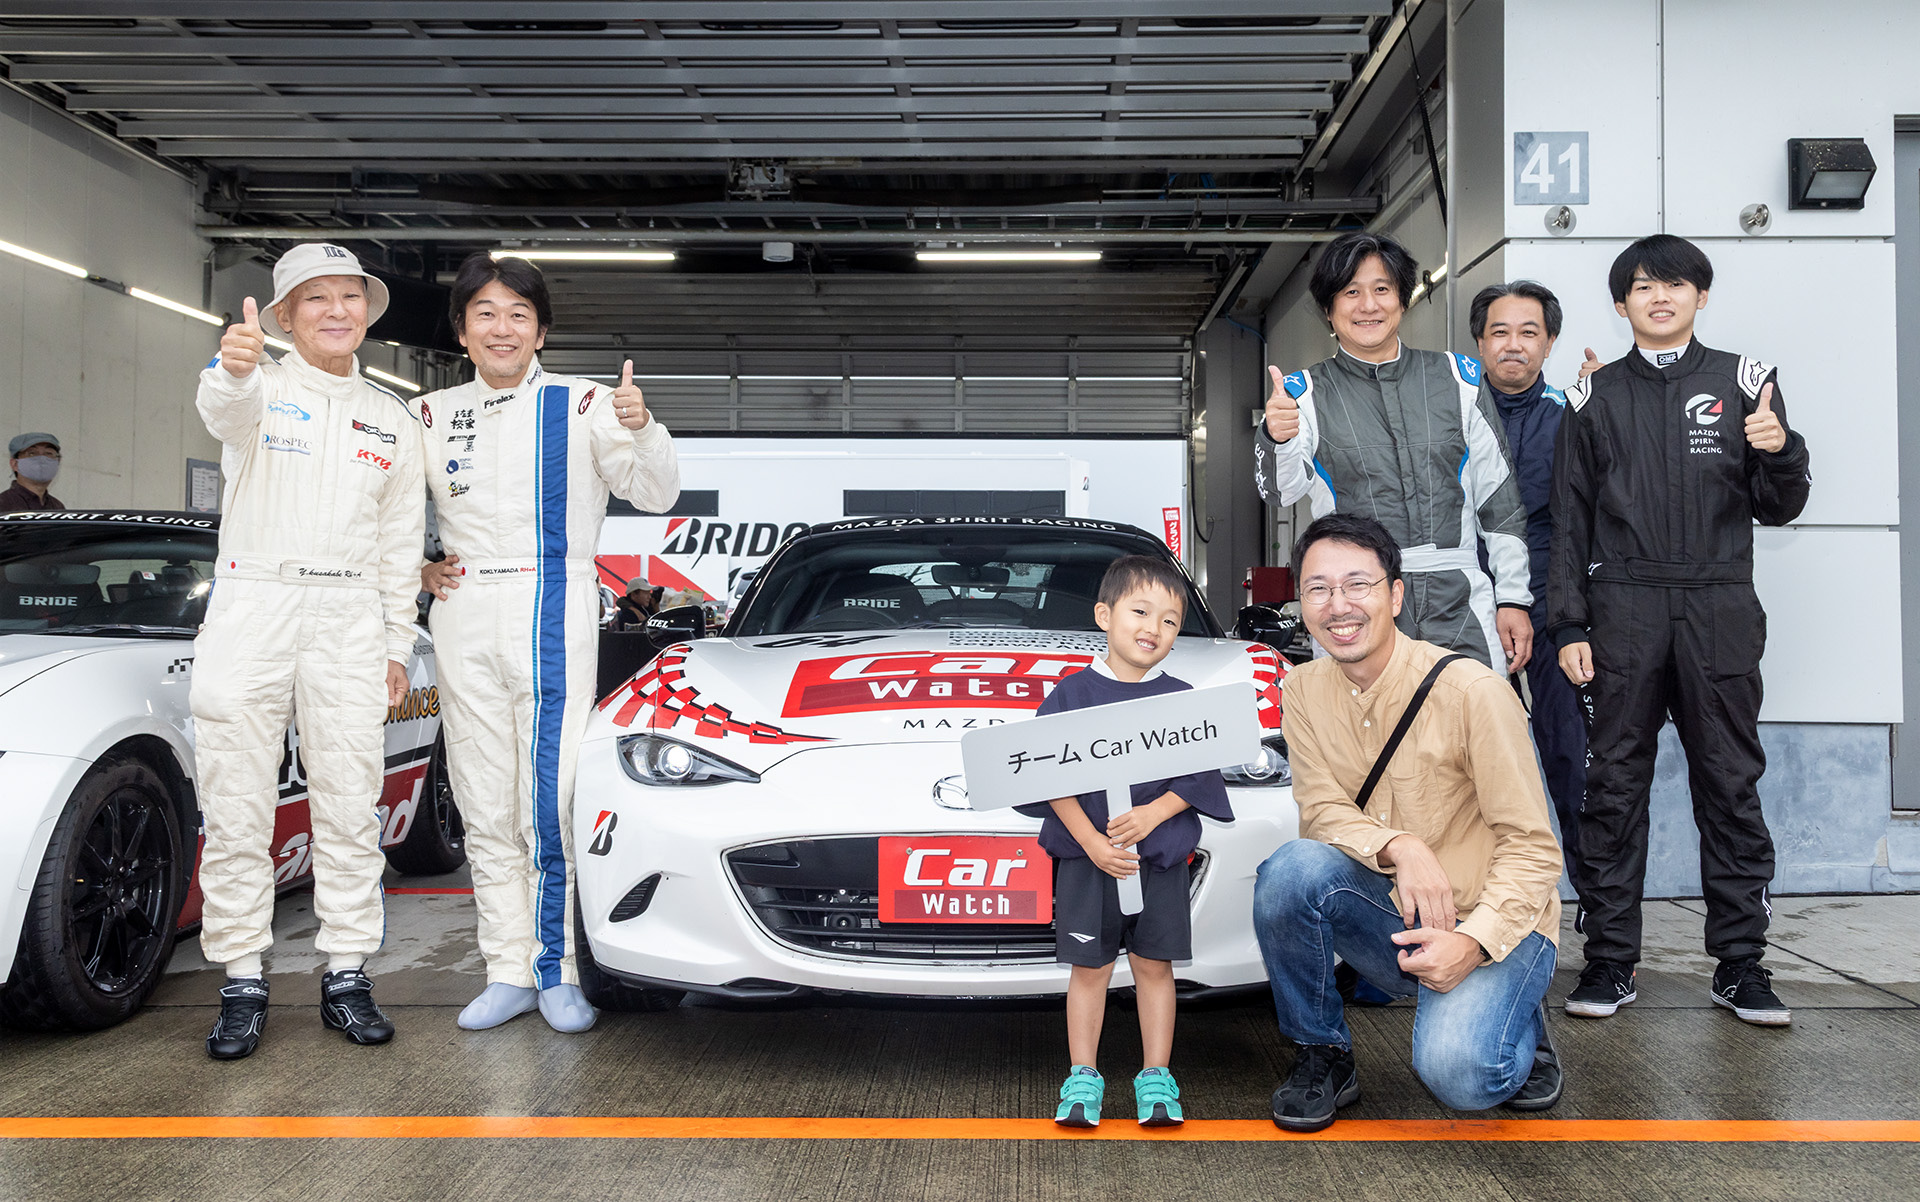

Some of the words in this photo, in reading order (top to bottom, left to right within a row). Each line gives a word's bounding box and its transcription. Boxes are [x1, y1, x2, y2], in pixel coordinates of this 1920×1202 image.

[1520, 142, 1580, 194] 41
[1689, 429, 1720, 437] MAZDA
[357, 449, 392, 470] KYB
[1690, 446, 1722, 454] RACING
[20, 511, 104, 521] SPIRIT
[109, 513, 213, 528] RACING
[831, 517, 925, 531] MAZDA
[1021, 517, 1117, 531] RACING
[19, 596, 78, 607] BRIDE
[829, 653, 1094, 681] Car
[1008, 743, 1082, 775] チーム
[1090, 738, 1134, 760] Car
[1140, 719, 1218, 751] Watch
[903, 848, 1028, 887] Car
[921, 893, 1010, 915] Watch
